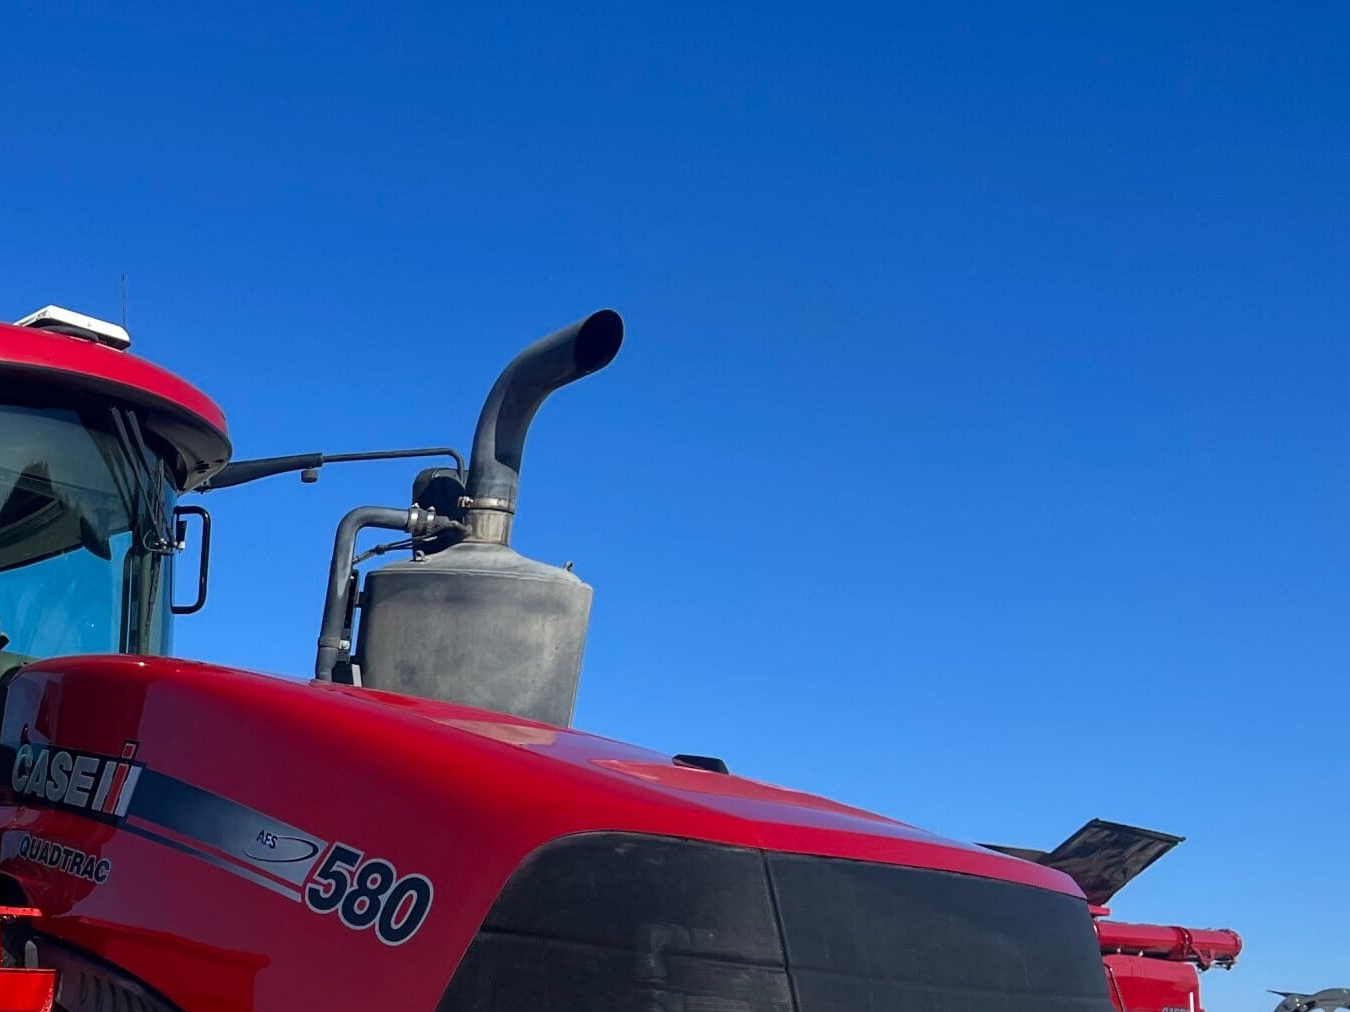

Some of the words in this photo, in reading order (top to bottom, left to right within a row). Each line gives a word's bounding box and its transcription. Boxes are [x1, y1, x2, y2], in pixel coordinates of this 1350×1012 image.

[11, 743, 100, 808] CASE
[19, 833, 111, 885] QUADTRAC
[256, 829, 278, 850] AFS
[305, 841, 434, 946] 580
